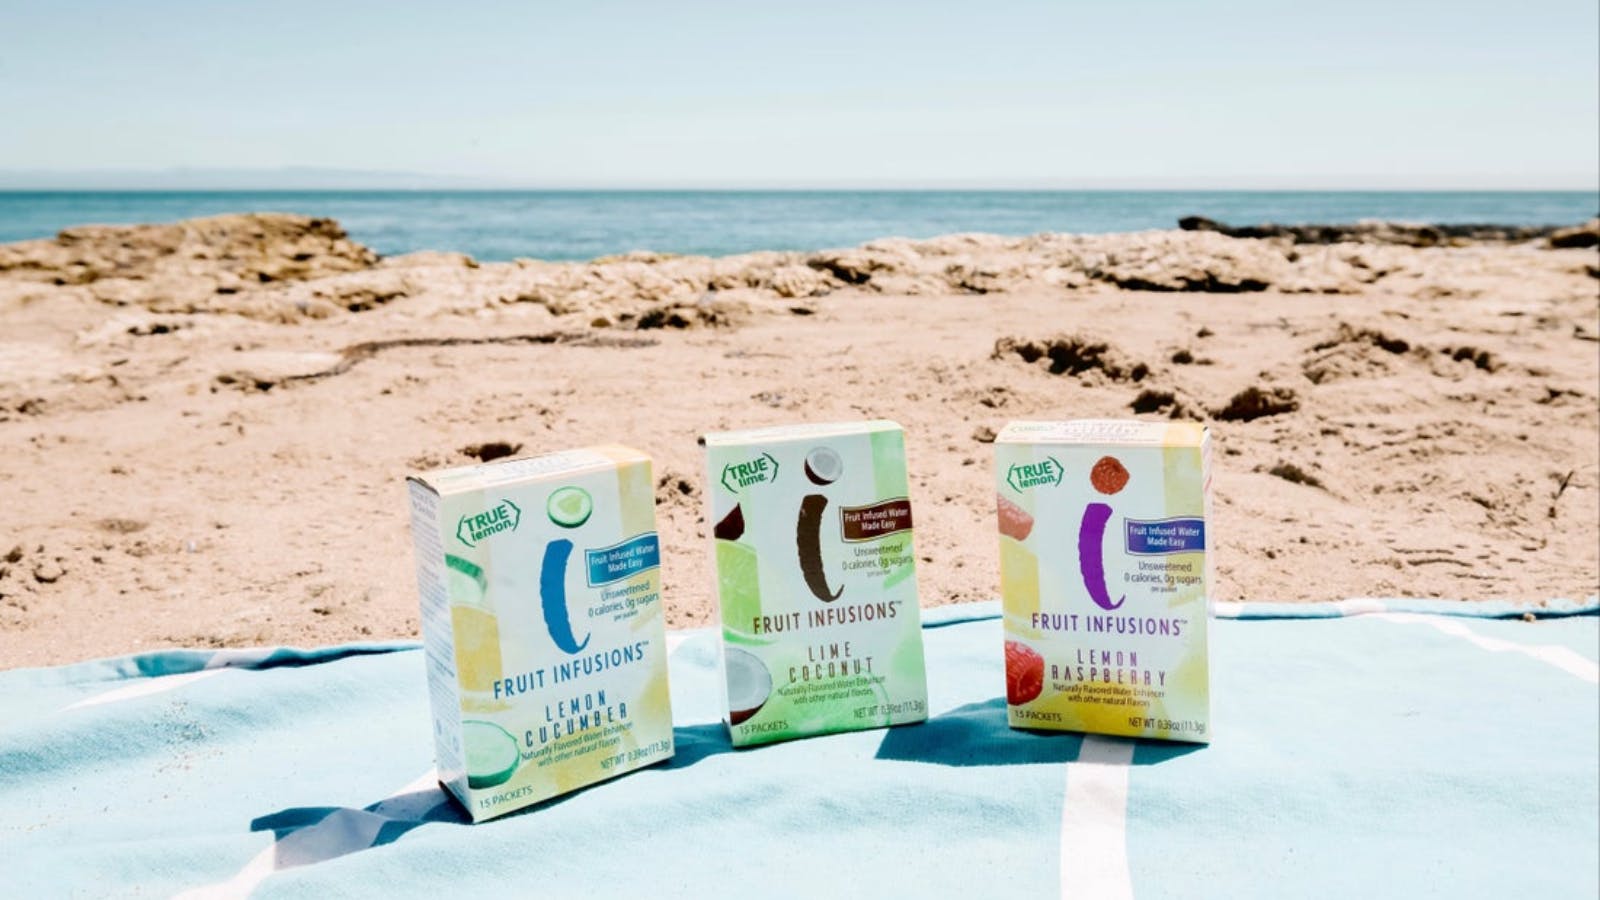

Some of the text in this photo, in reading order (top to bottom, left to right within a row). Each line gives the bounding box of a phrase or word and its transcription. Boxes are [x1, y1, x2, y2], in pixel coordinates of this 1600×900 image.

[728, 457, 768, 479] TRUE
[1012, 461, 1054, 479] TRUE
[464, 504, 509, 532] TRUE
[845, 513, 861, 522] Fruit
[888, 508, 908, 517] Water
[862, 519, 896, 531] Made Easy
[1130, 526, 1200, 537] Fruit Infused Water
[854, 543, 903, 557] Unsweetened
[1147, 537, 1185, 548] Made Easy
[591, 544, 655, 565] Fruit Infused Water
[890, 555, 914, 567] sugars
[608, 558, 644, 573] Made Easy
[1138, 560, 1192, 572] Unsweetened
[1176, 575, 1202, 586] sugars
[601, 580, 650, 601] Unsweetened
[636, 592, 660, 606] sugars
[753, 612, 801, 635] FRUIT
[1031, 612, 1078, 631] FRUIT
[808, 641, 852, 662] LIME
[1077, 648, 1138, 667] LEMON
[789, 657, 873, 683] COCONUT
[1051, 665, 1166, 687] RASPBERRY
[493, 669, 545, 700] FRUIT
[778, 686, 807, 697] Naturally
[808, 681, 836, 692] Flavored
[1053, 683, 1082, 694] Naturally
[1083, 684, 1111, 695] Flavored
[1112, 686, 1131, 696] Water
[827, 689, 850, 700] natural
[1067, 694, 1082, 703] with
[1083, 695, 1102, 704] other
[1103, 696, 1126, 706] natural
[545, 690, 606, 722] LEMON
[854, 707, 867, 718] NET
[525, 702, 627, 747] CUCUMBER
[1014, 711, 1062, 723] 15 PACKETS
[1128, 717, 1141, 728] NET
[1144, 718, 1155, 729] WT
[740, 720, 789, 735] 15 PACKETS
[521, 744, 552, 761] Naturally
[553, 735, 583, 752] Flavored
[583, 730, 603, 744] Water
[538, 755, 553, 767] with
[554, 750, 574, 763] other
[574, 742, 598, 757] natural
[601, 757, 614, 769] NET
[480, 785, 533, 809] 15 PACKETS
